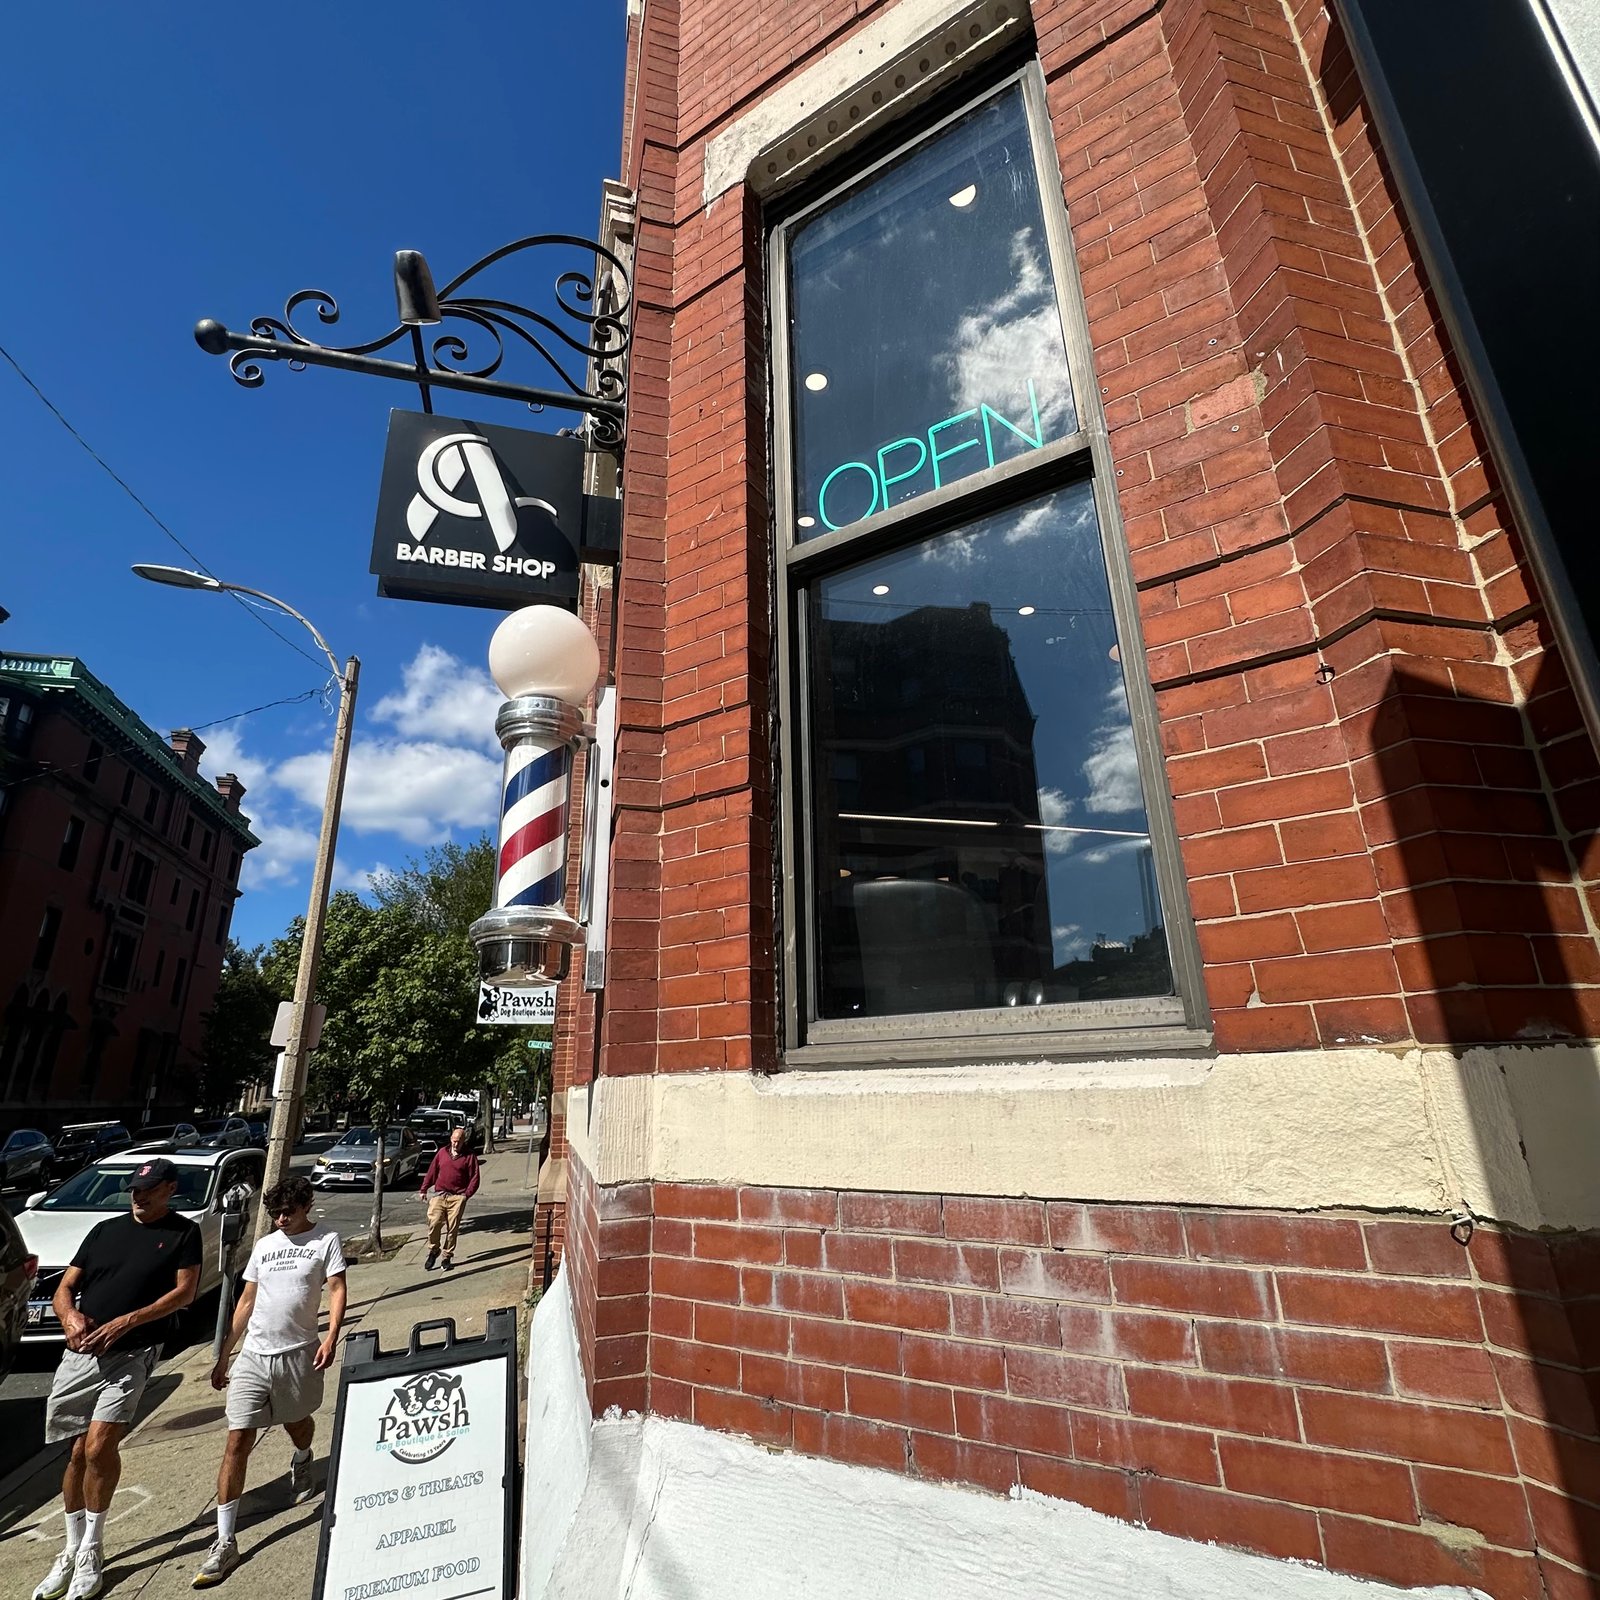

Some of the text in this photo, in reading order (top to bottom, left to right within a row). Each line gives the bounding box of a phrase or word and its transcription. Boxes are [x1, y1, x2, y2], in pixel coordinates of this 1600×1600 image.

[818, 378, 1043, 531] OPEN
[396, 543, 556, 578] BARBER SHOP
[500, 1008, 511, 1018] Dog
[512, 1008, 536, 1018] Boutique
[501, 991, 554, 1007] Pawsh
[261, 1248, 316, 1264] MIAMI BEACH
[376, 1399, 470, 1444] Pawsh
[375, 1442, 393, 1452] Dog
[396, 1434, 435, 1447] Boutique
[446, 1427, 470, 1438] Salon
[399, 1448, 426, 1458] Celebrating
[353, 1471, 483, 1511] TOYS & TREATS
[375, 1519, 456, 1550] APPAREL
[344, 1557, 480, 1600] PREMIUM FOOD
